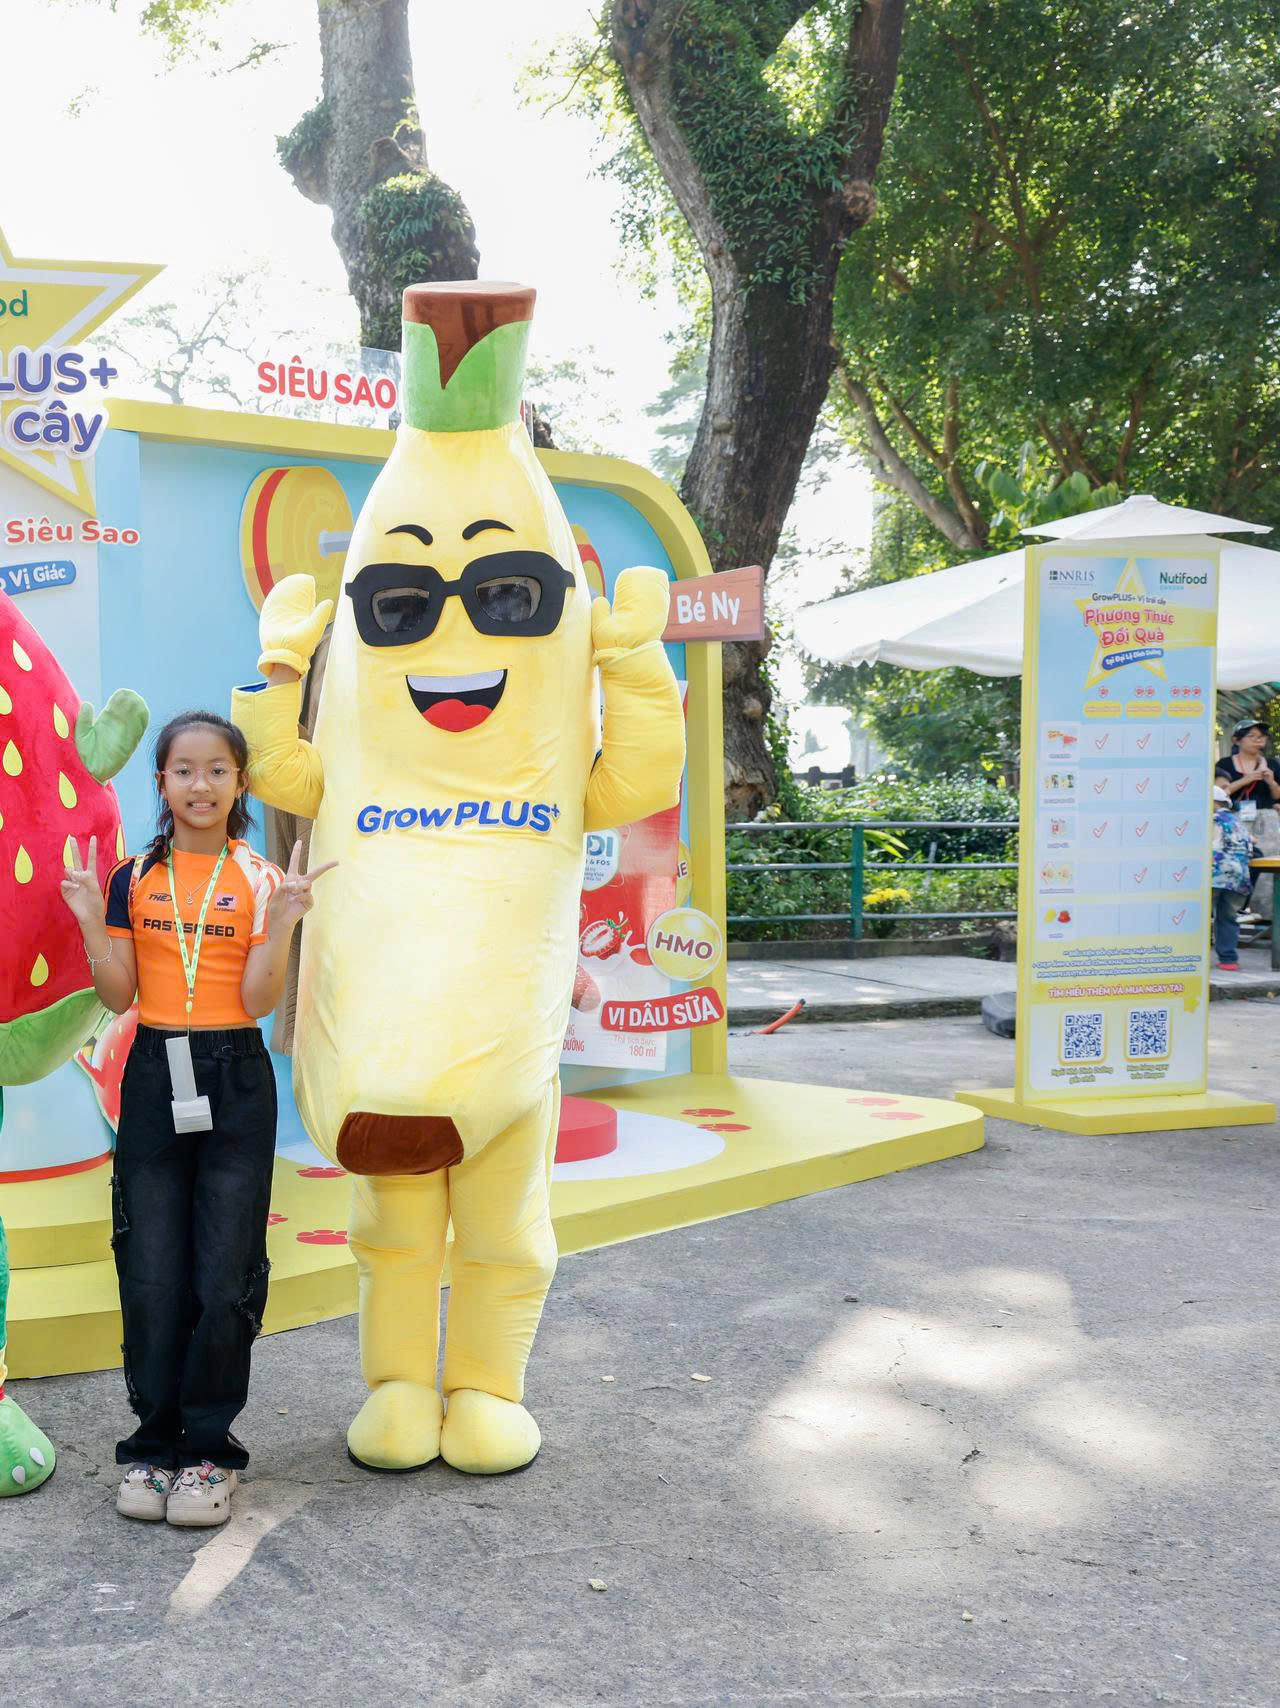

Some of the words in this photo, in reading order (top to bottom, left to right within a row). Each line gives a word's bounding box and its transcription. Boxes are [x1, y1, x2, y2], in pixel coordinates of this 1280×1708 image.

[257, 354, 328, 401] SIÊU
[333, 373, 397, 410] SAO
[13, 401, 103, 453] cây
[7, 517, 73, 544] Siêu
[81, 520, 139, 545] Sao
[8, 567, 31, 590] Vị
[33, 566, 67, 581] Giác
[1159, 571, 1208, 585] Nutifood
[676, 590, 707, 624] Bé
[711, 590, 740, 626] Ny
[356, 799, 561, 834] GrowPLUS+
[655, 931, 713, 960] HMO
[608, 1006, 625, 1030] VỊ
[629, 1002, 669, 1027] DÂU
[672, 995, 721, 1026] SỮA
[630, 1045, 644, 1057] 180
[645, 1046, 657, 1057] ml
